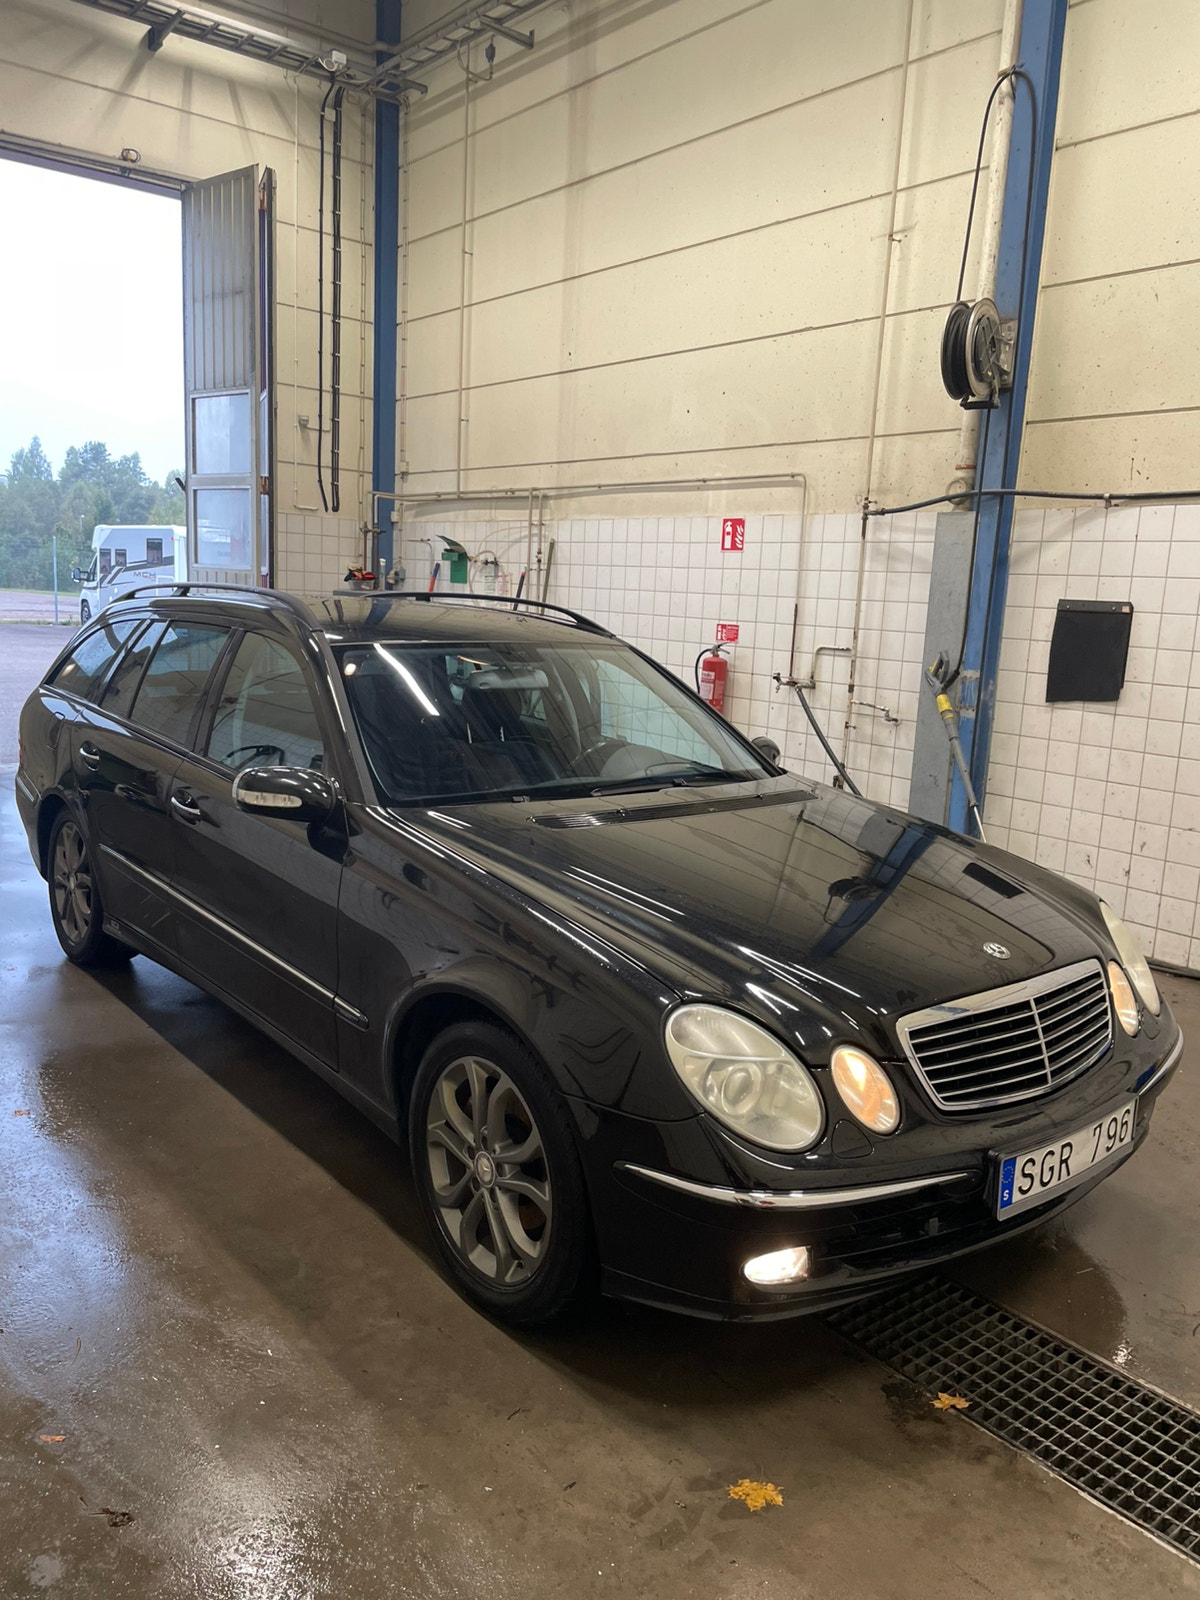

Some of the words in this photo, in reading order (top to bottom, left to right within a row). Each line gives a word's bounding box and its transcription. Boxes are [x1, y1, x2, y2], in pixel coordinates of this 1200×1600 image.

[1018, 1142, 1073, 1195] SGR
[1091, 1108, 1131, 1163] 796
[1003, 1190, 1010, 1200] S
